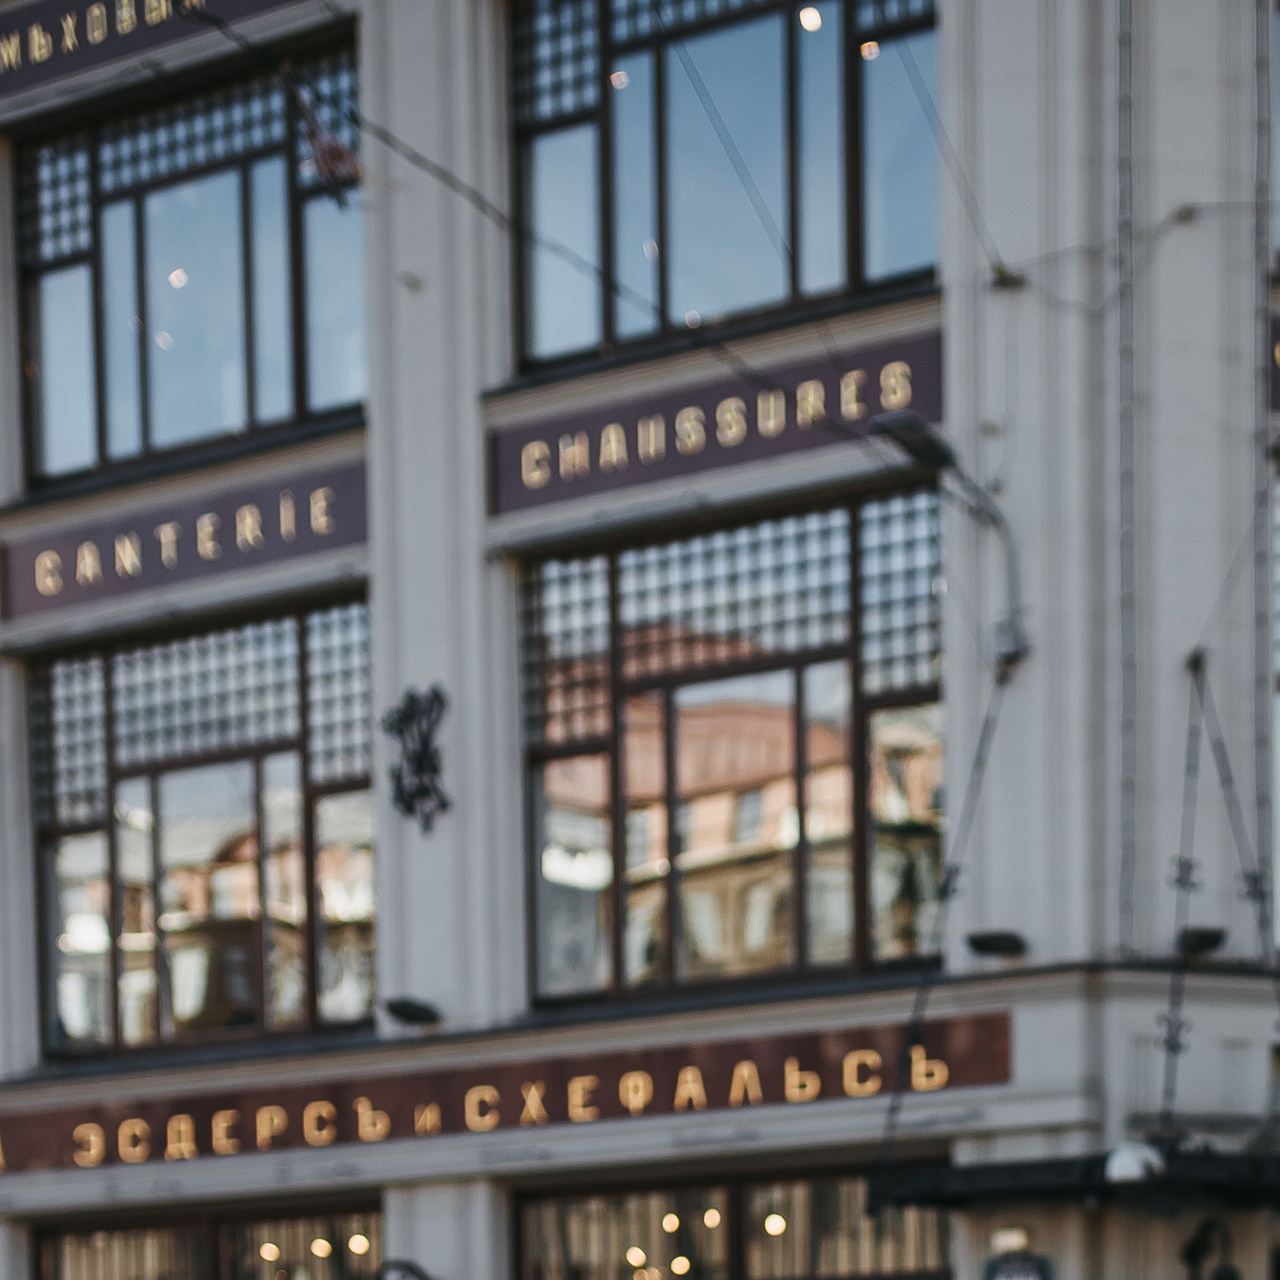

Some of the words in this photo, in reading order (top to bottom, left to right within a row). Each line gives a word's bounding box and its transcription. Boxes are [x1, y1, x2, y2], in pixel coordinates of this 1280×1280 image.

[520, 360, 913, 490] CHAUSSURES
[72, 1096, 392, 1168] ЭСДЕРСЪ
[463, 1044, 950, 1133] СХЕФАЛЬСЪ
